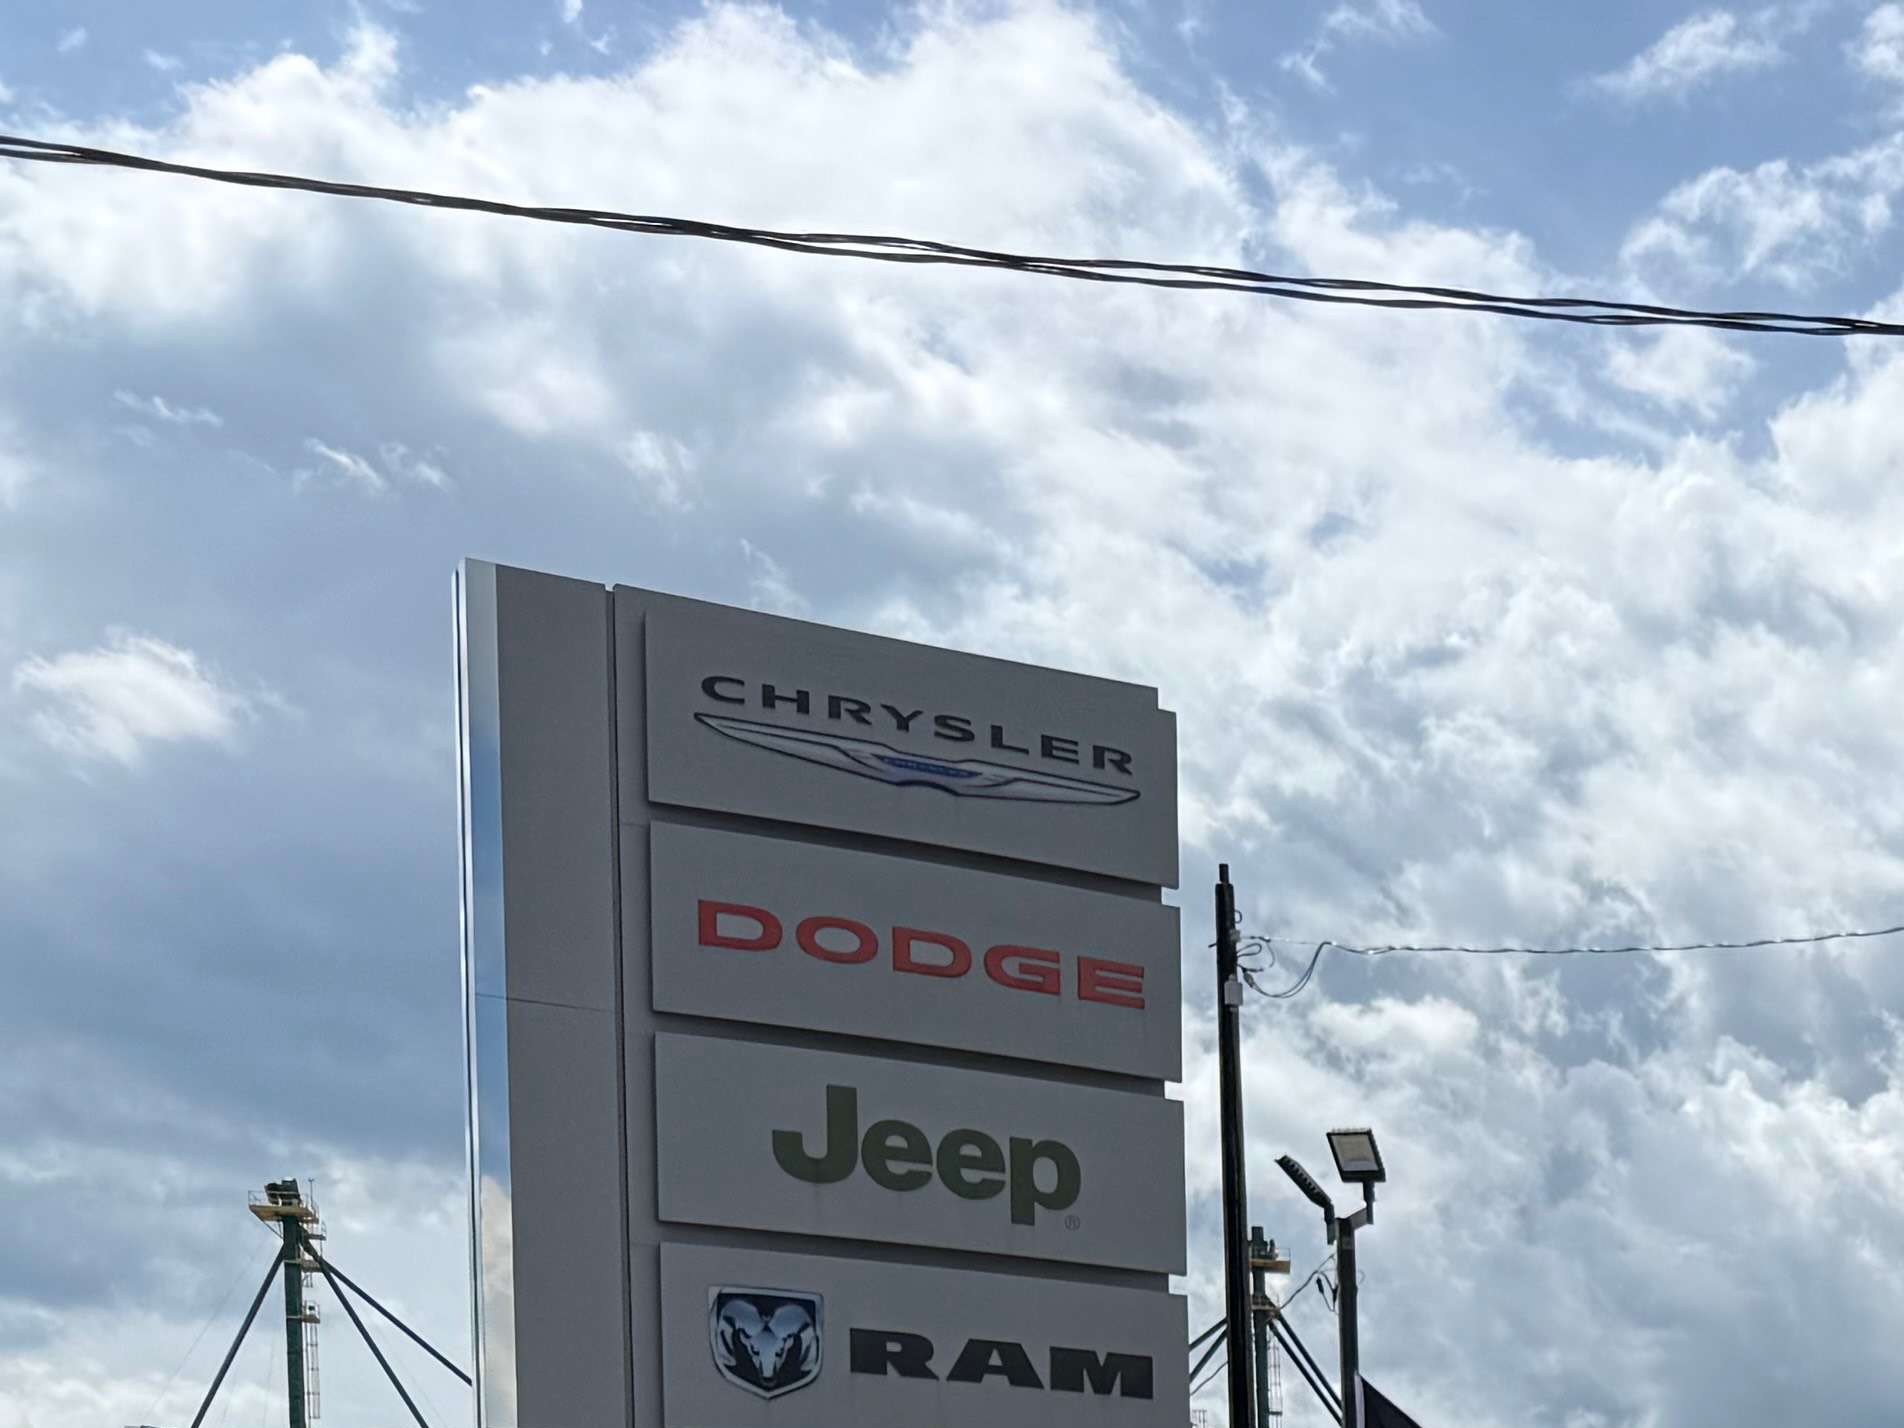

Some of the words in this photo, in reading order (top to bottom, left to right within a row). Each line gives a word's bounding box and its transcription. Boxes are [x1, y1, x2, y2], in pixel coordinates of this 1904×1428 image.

[701, 675, 1134, 777] CHRYSLER
[697, 899, 1147, 1010] DODGE
[771, 1084, 1082, 1225] Jeep
[849, 1327, 1154, 1400] RAM
